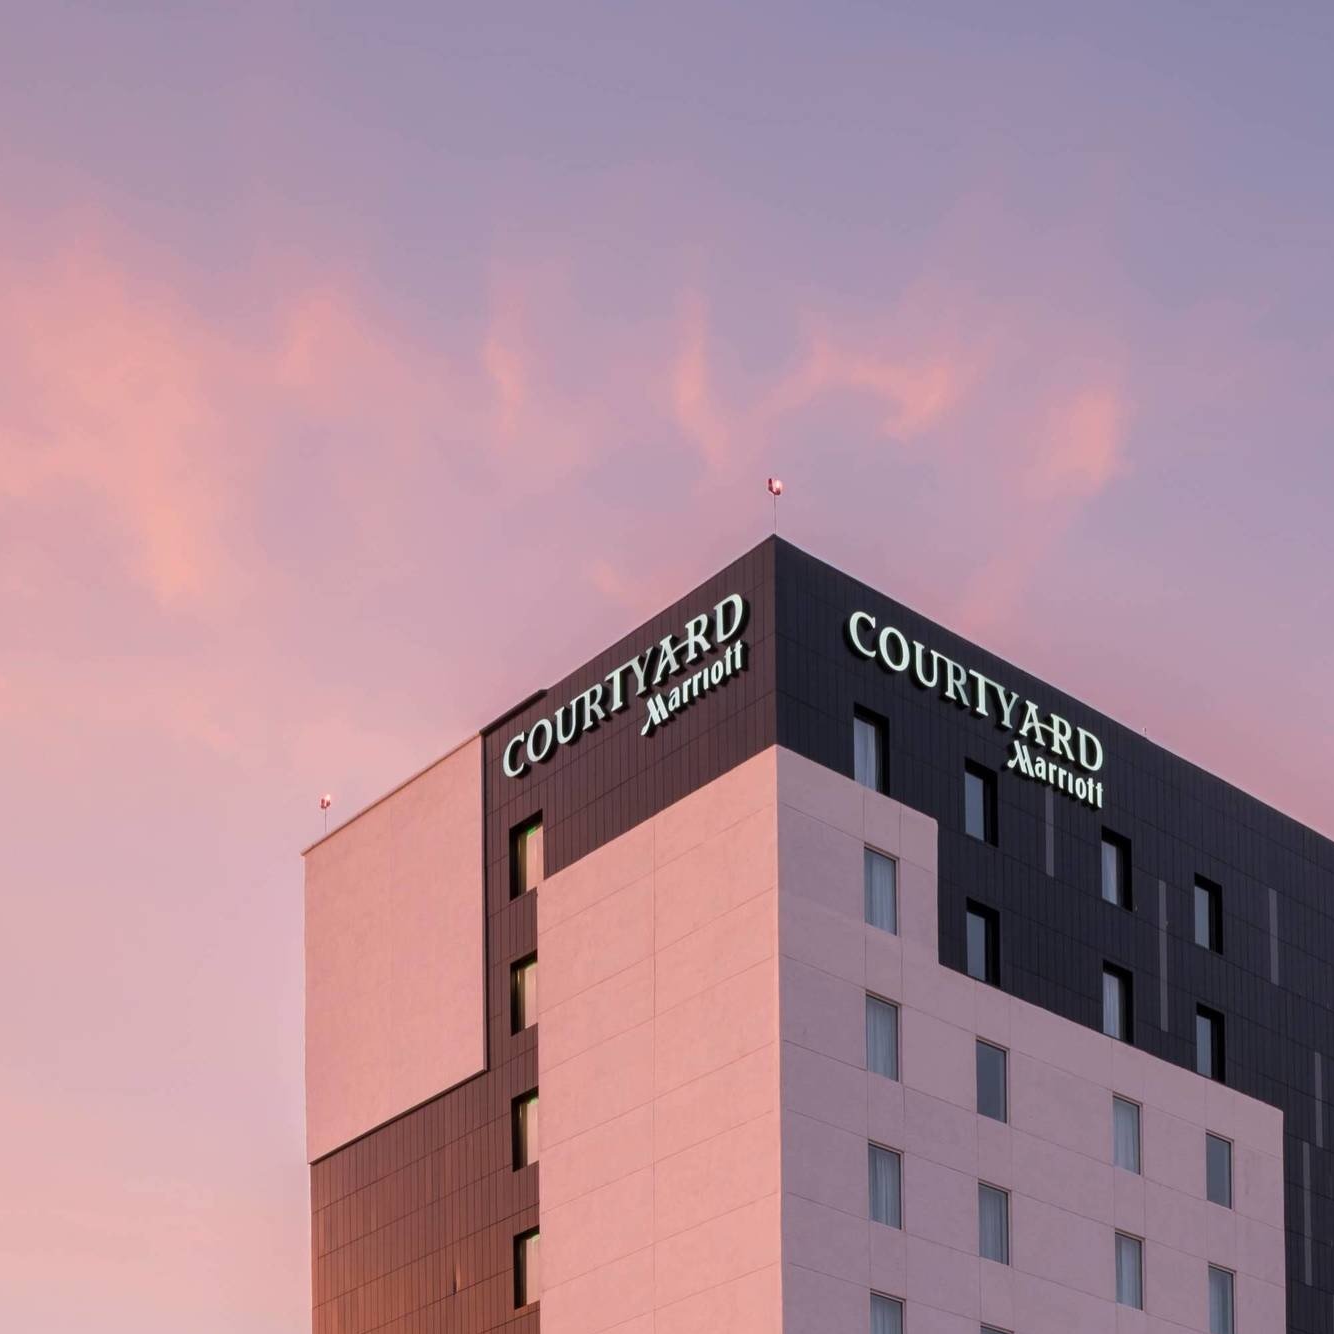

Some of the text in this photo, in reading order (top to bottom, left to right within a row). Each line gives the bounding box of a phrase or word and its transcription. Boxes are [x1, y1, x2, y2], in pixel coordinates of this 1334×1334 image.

[503, 593, 743, 777] COURTYARD
[641, 639, 743, 736] Marriott
[849, 611, 1103, 771] COURTYARD
[1007, 739, 1103, 808] Marriott
